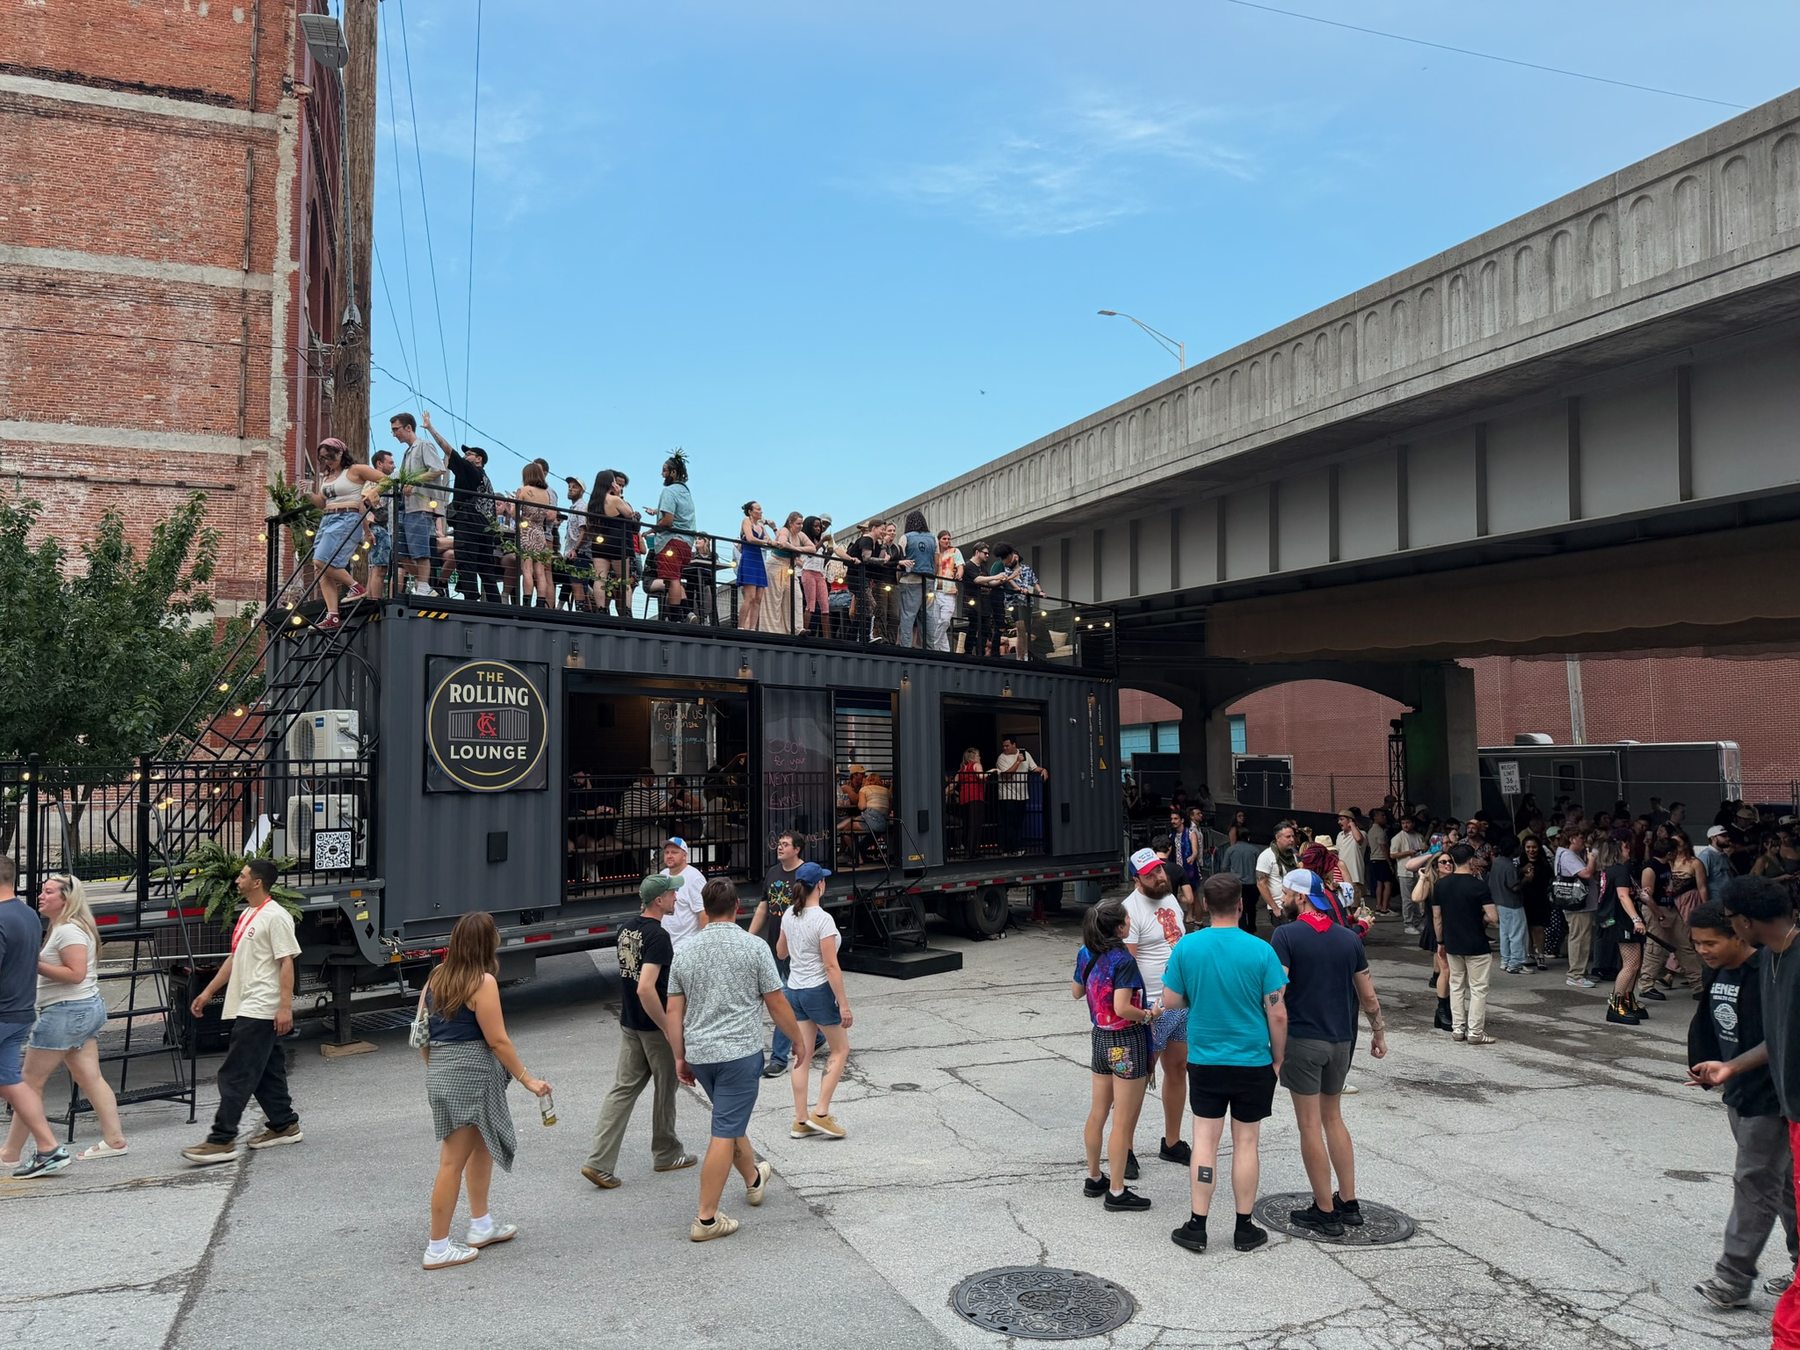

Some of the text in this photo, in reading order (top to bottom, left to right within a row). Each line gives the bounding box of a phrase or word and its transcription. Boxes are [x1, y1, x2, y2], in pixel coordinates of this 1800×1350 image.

[476, 671, 504, 682] THE
[449, 684, 529, 706] ROLLING
[450, 745, 527, 759] LOUNGE
